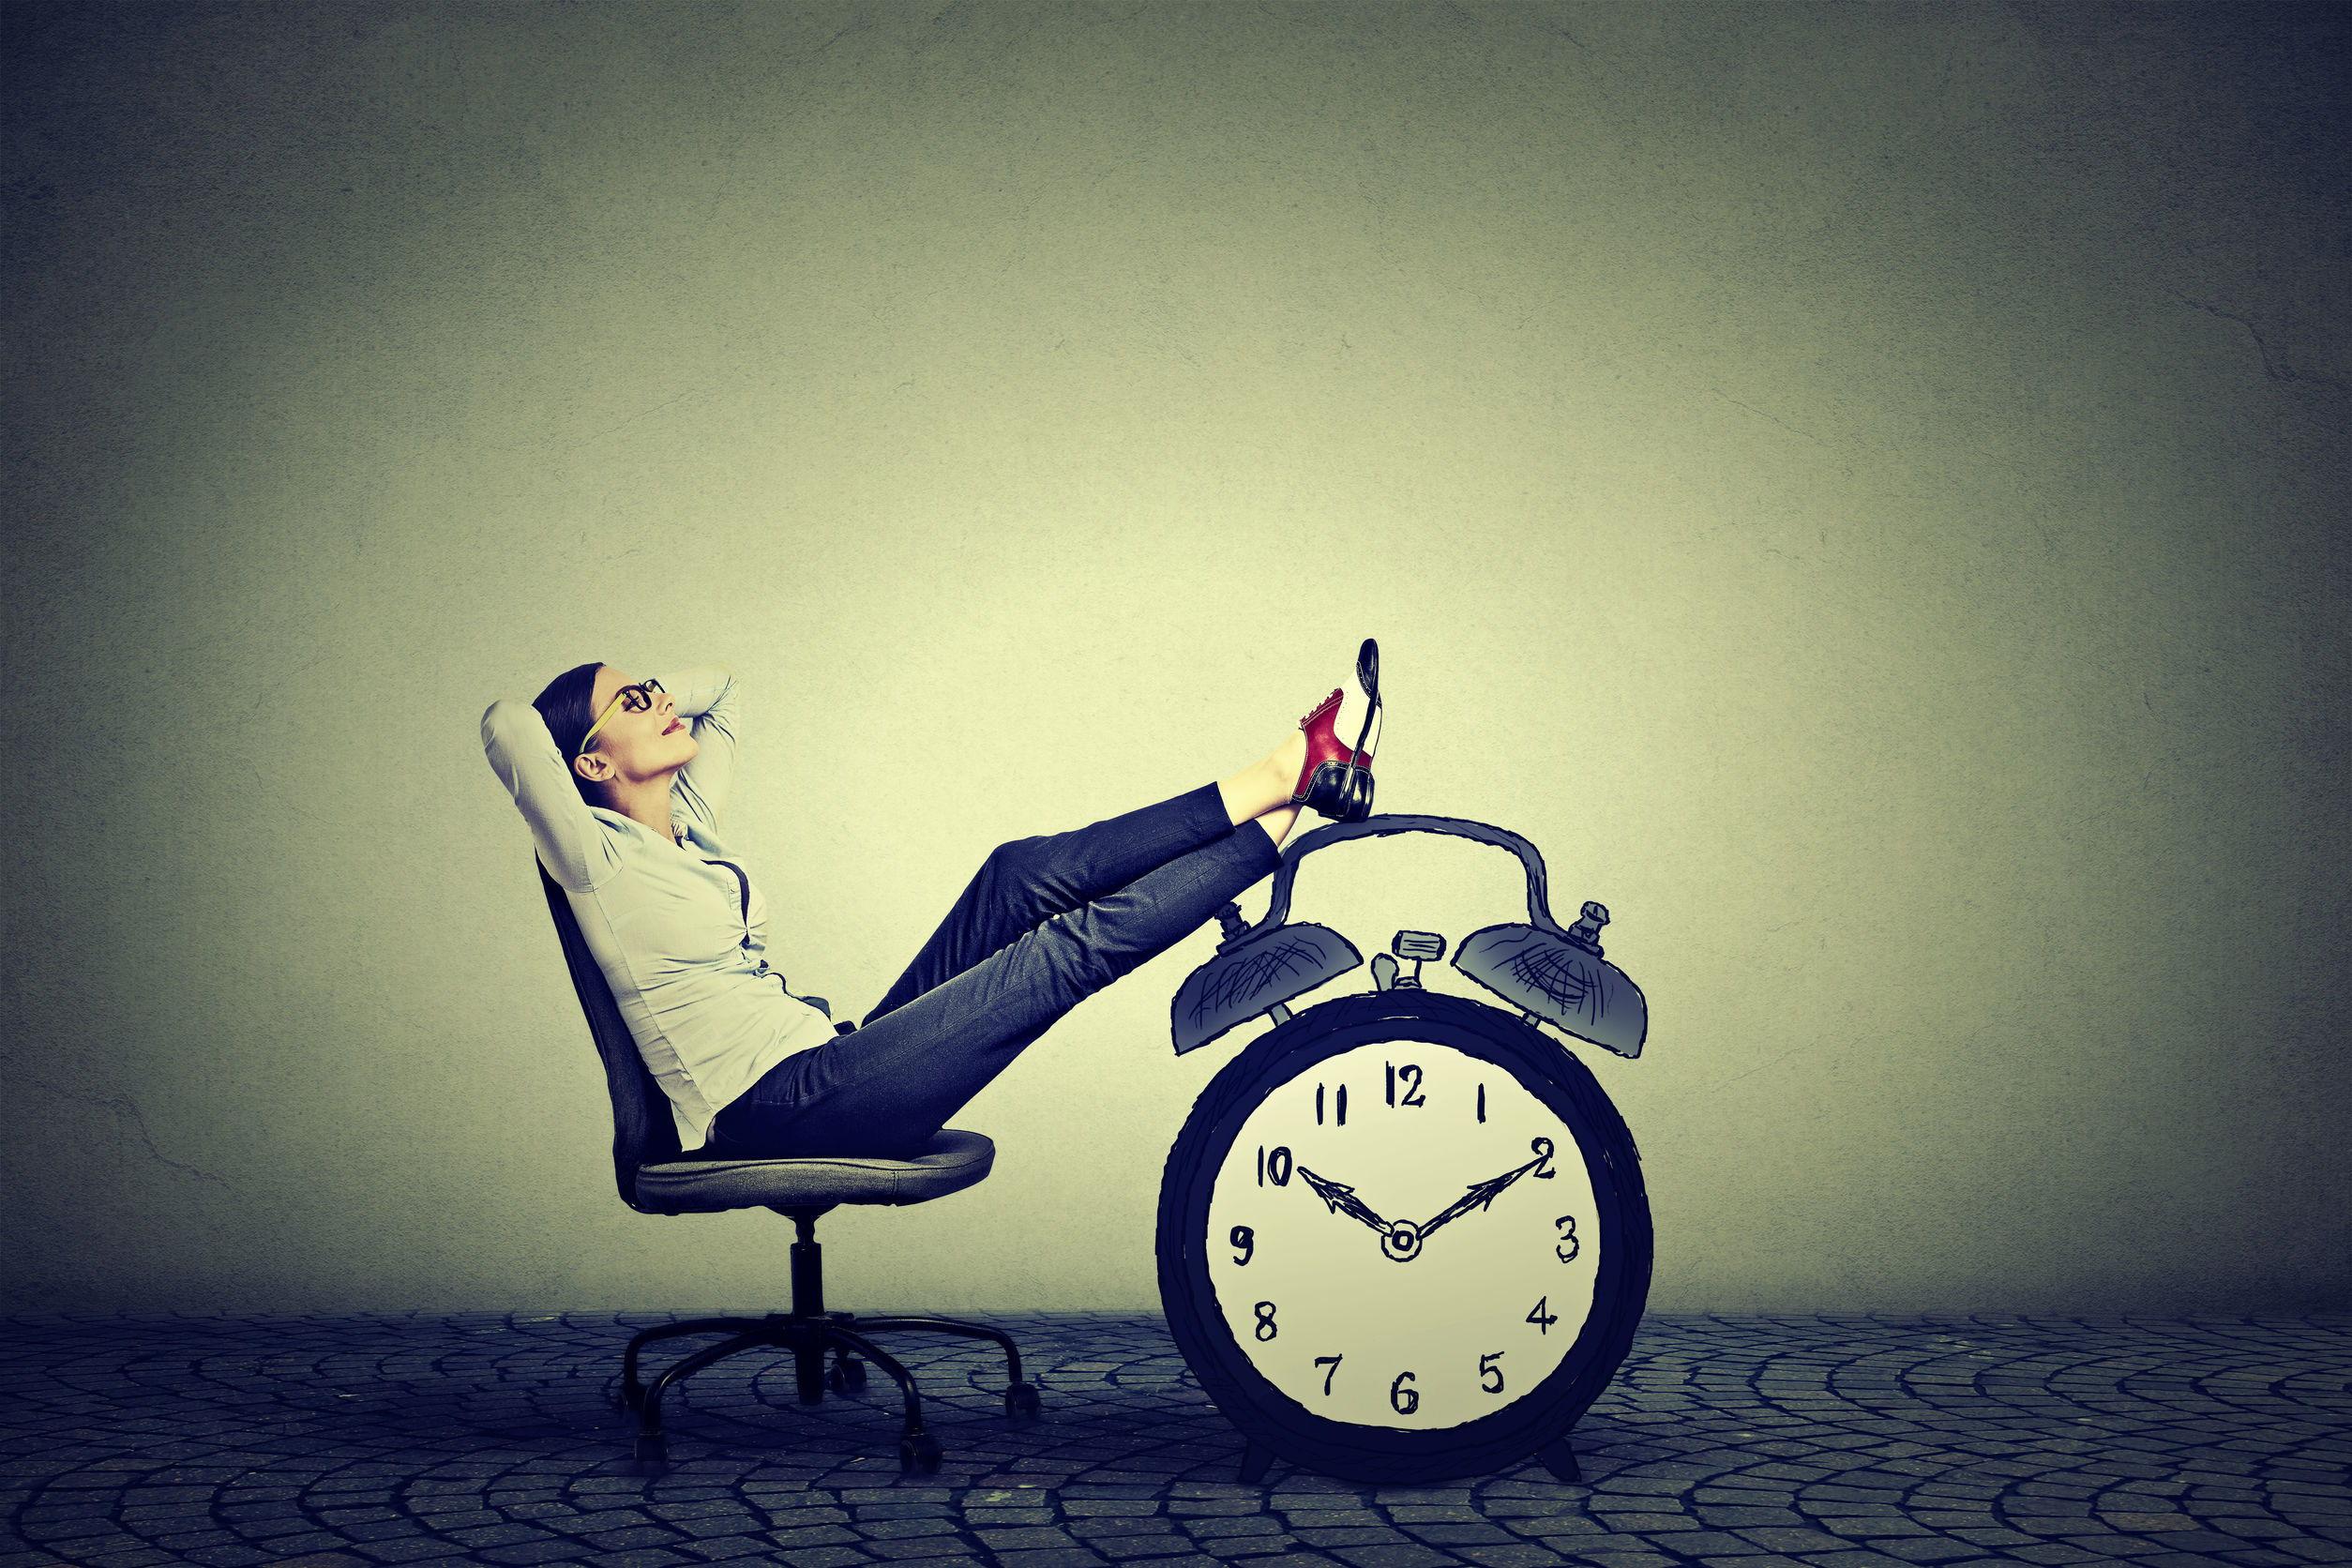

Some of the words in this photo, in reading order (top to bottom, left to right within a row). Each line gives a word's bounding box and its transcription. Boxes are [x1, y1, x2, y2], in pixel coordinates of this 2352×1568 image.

[1317, 1083, 1347, 1126] 11
[1386, 1061, 1425, 1108] 12
[1477, 1083, 1485, 1123] 1
[1258, 1146, 1292, 1187] 10
[1530, 1138, 1556, 1179] 2
[1230, 1226, 1254, 1266] 9
[1556, 1215, 1579, 1263] 3
[1255, 1302, 1277, 1342] 8
[1526, 1296, 1558, 1335] 4
[1315, 1353, 1343, 1396] 7
[1391, 1371, 1419, 1415] 6
[1479, 1351, 1504, 1394] 5
